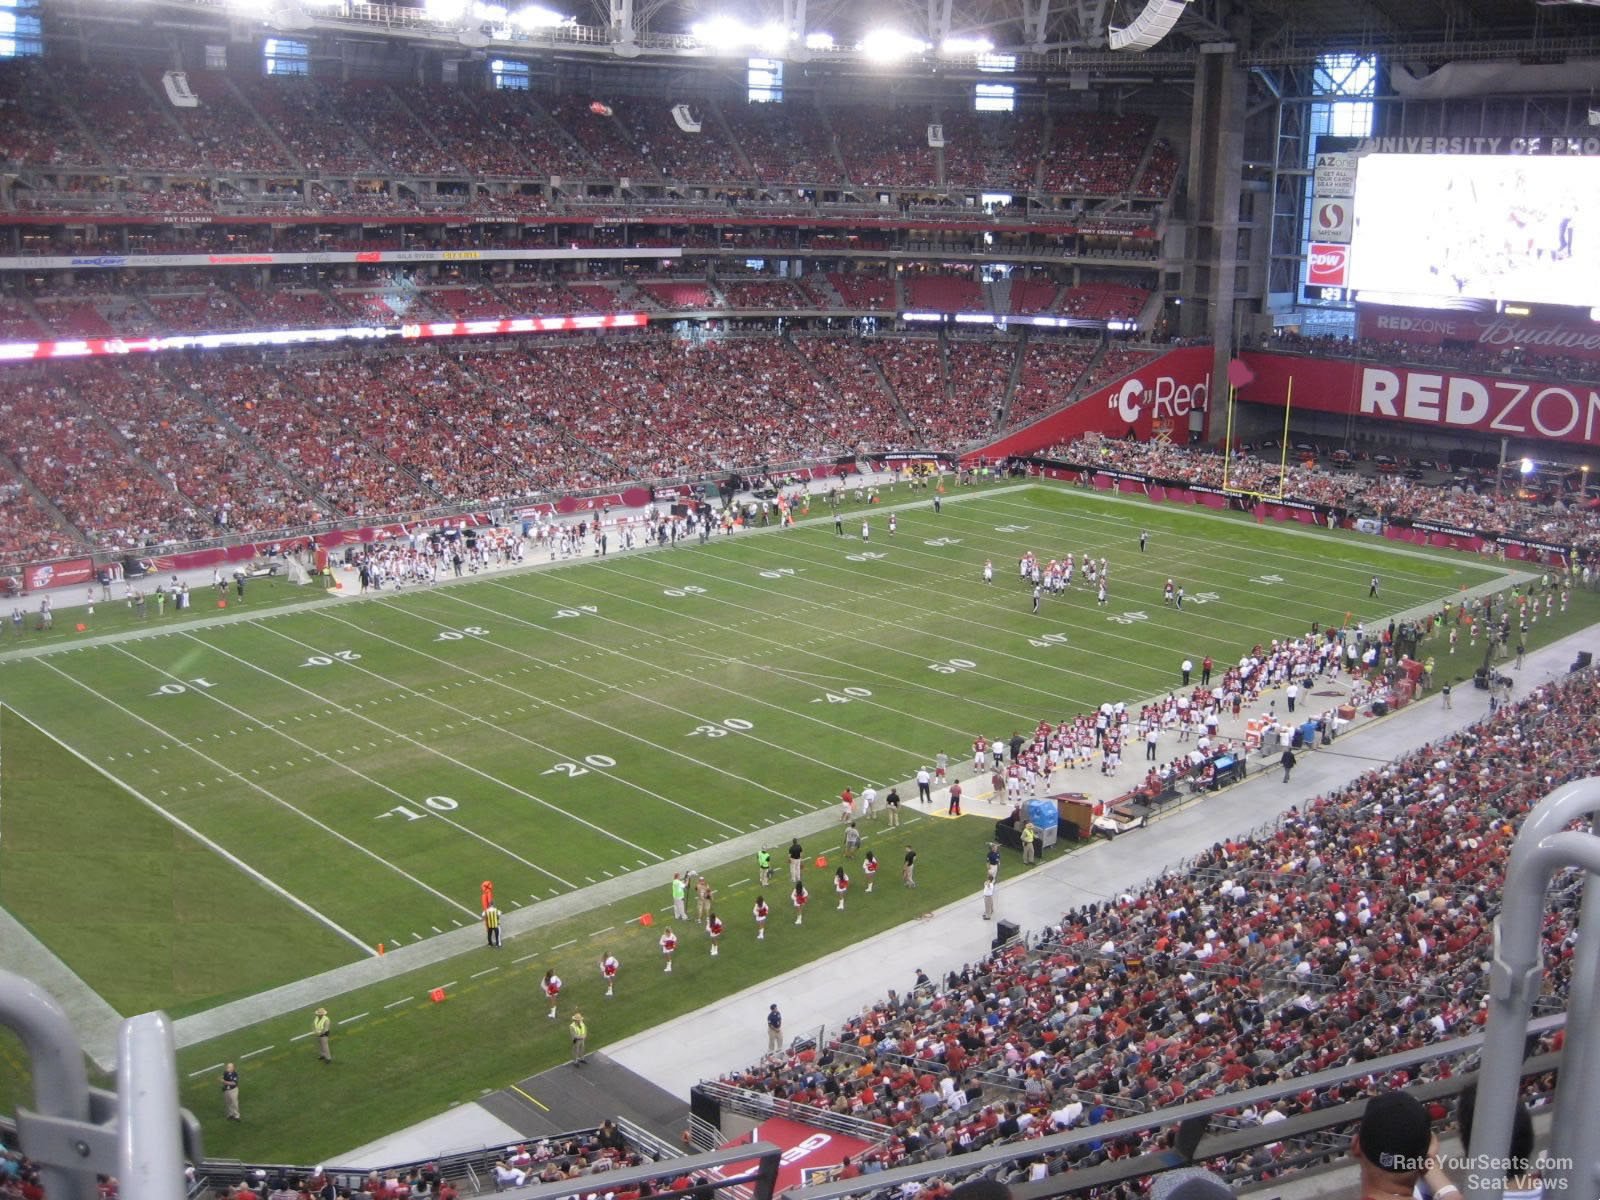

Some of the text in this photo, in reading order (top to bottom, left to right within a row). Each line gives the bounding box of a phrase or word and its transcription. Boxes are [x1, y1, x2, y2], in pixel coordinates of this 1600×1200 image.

[1362, 136, 1501, 154] UNIVERSITY
[1510, 138, 1540, 155] OF
[1311, 253, 1340, 266] CDW
[1377, 315, 1456, 335] REDZONE
[1152, 372, 1210, 418] Red
[439, 626, 490, 641] 30
[308, 650, 362, 667] 20
[928, 658, 977, 674] 50
[826, 687, 873, 704] 40
[696, 718, 754, 738] 30
[554, 754, 617, 778] 20
[391, 796, 459, 821] 10
